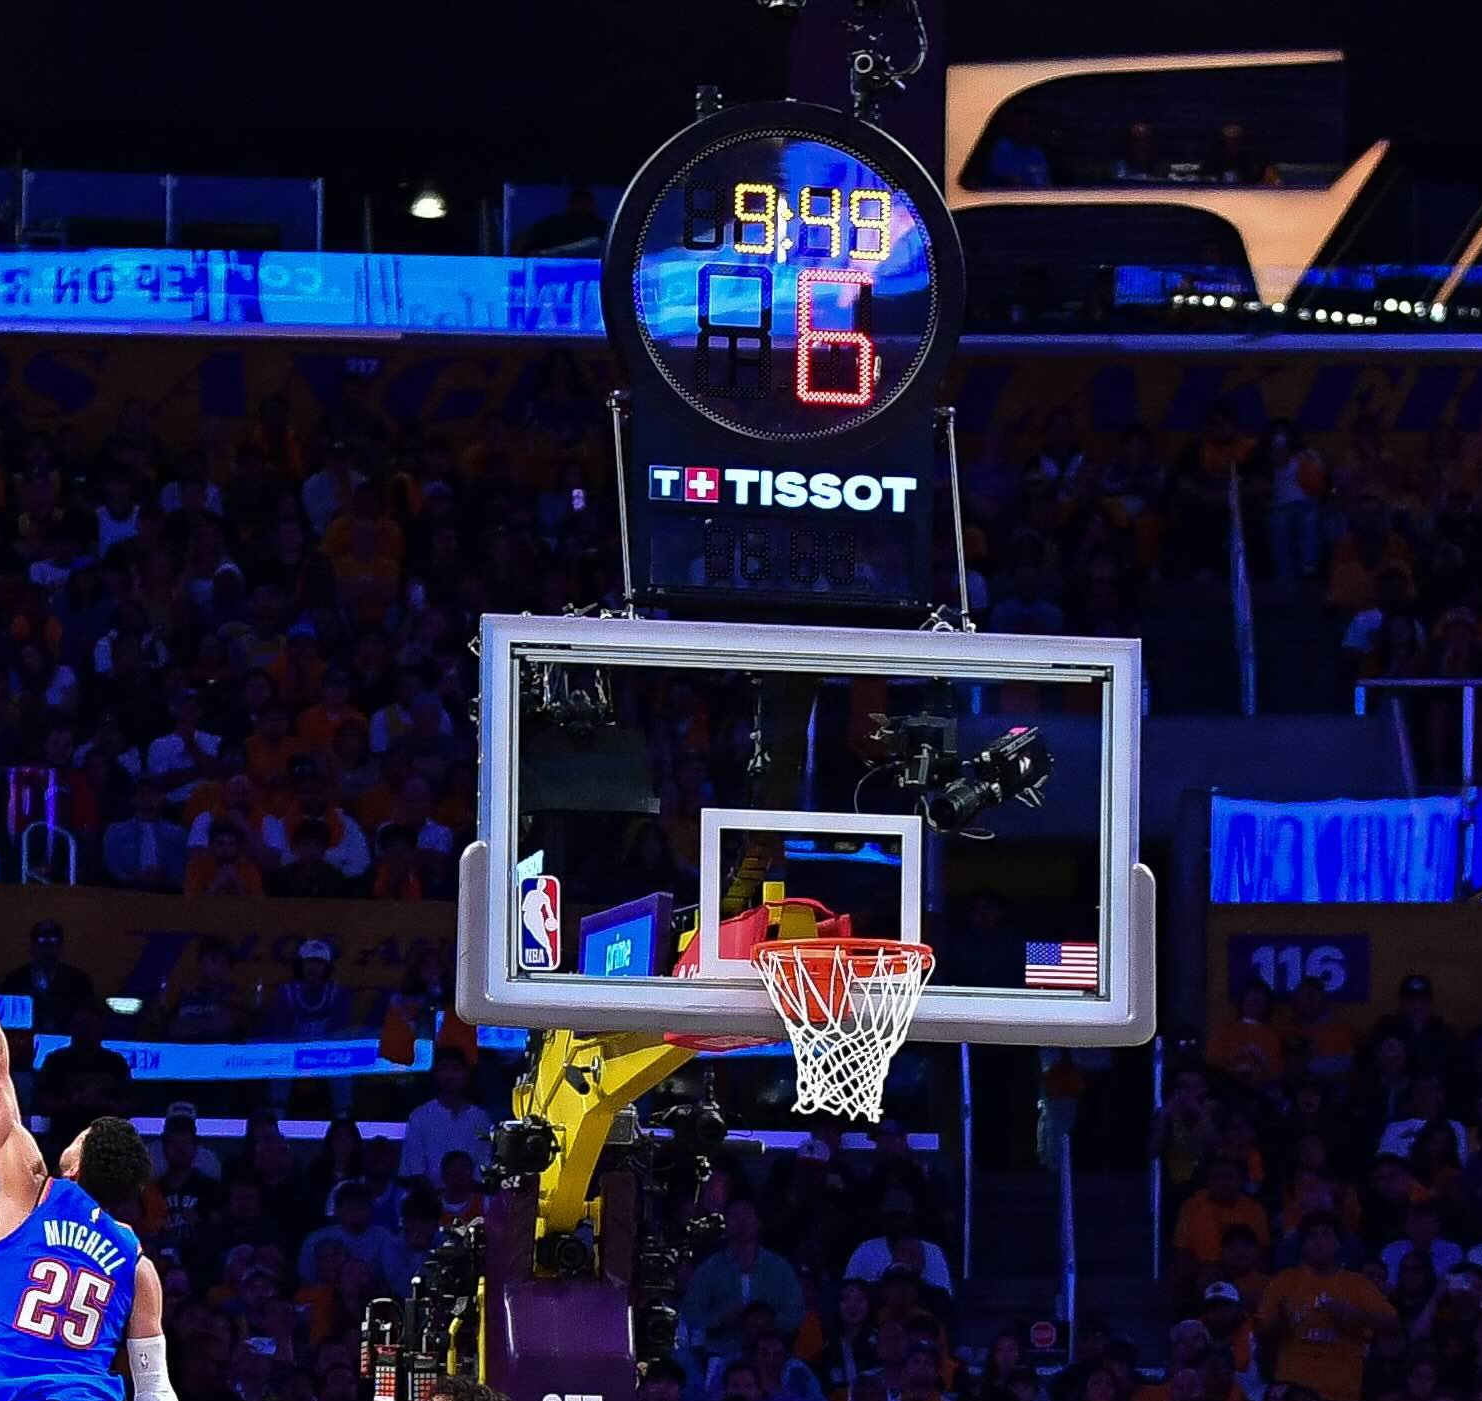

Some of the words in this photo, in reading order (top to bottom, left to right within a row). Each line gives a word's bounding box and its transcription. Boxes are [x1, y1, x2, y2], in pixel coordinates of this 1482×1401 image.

[734, 183, 891, 262] 9:49
[797, 268, 873, 405] 6
[724, 468, 918, 513] TISSOT
[43, 1219, 127, 1276] MITCHELL
[12, 1257, 116, 1350] 25
